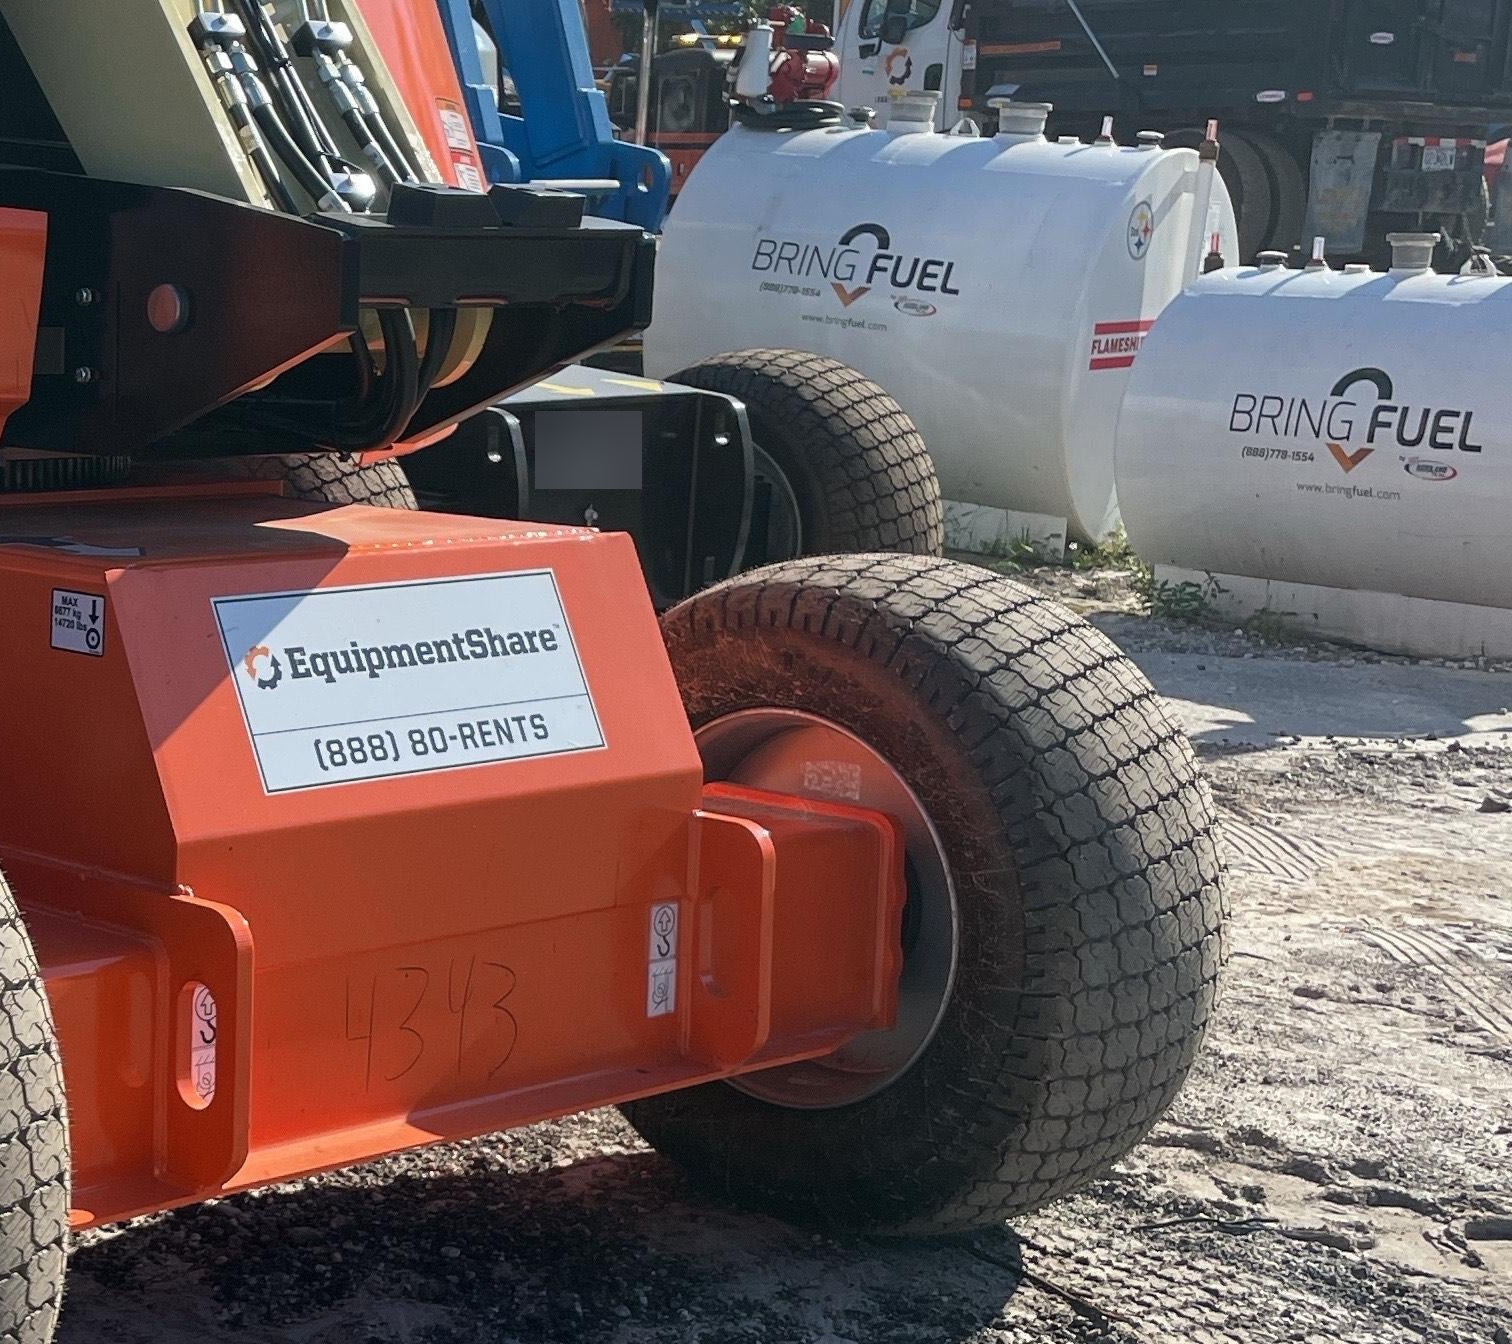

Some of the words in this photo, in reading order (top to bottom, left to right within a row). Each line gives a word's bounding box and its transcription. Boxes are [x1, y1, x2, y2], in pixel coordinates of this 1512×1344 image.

[751, 238, 860, 282] BRING
[865, 252, 960, 296] FUEL
[801, 312, 888, 332] www.bringfuel.com
[1091, 335, 1146, 356] FLAMESHI
[1229, 392, 1357, 443] BRING
[1366, 403, 1483, 454] FUEL
[1296, 480, 1401, 501] www.bringfuel.com
[62, 596, 78, 606] MAX
[284, 626, 559, 684] EquipmentShare
[313, 728, 400, 771] (888)
[409, 712, 550, 756] 80-RENTS
[345, 952, 518, 1094] 4343
